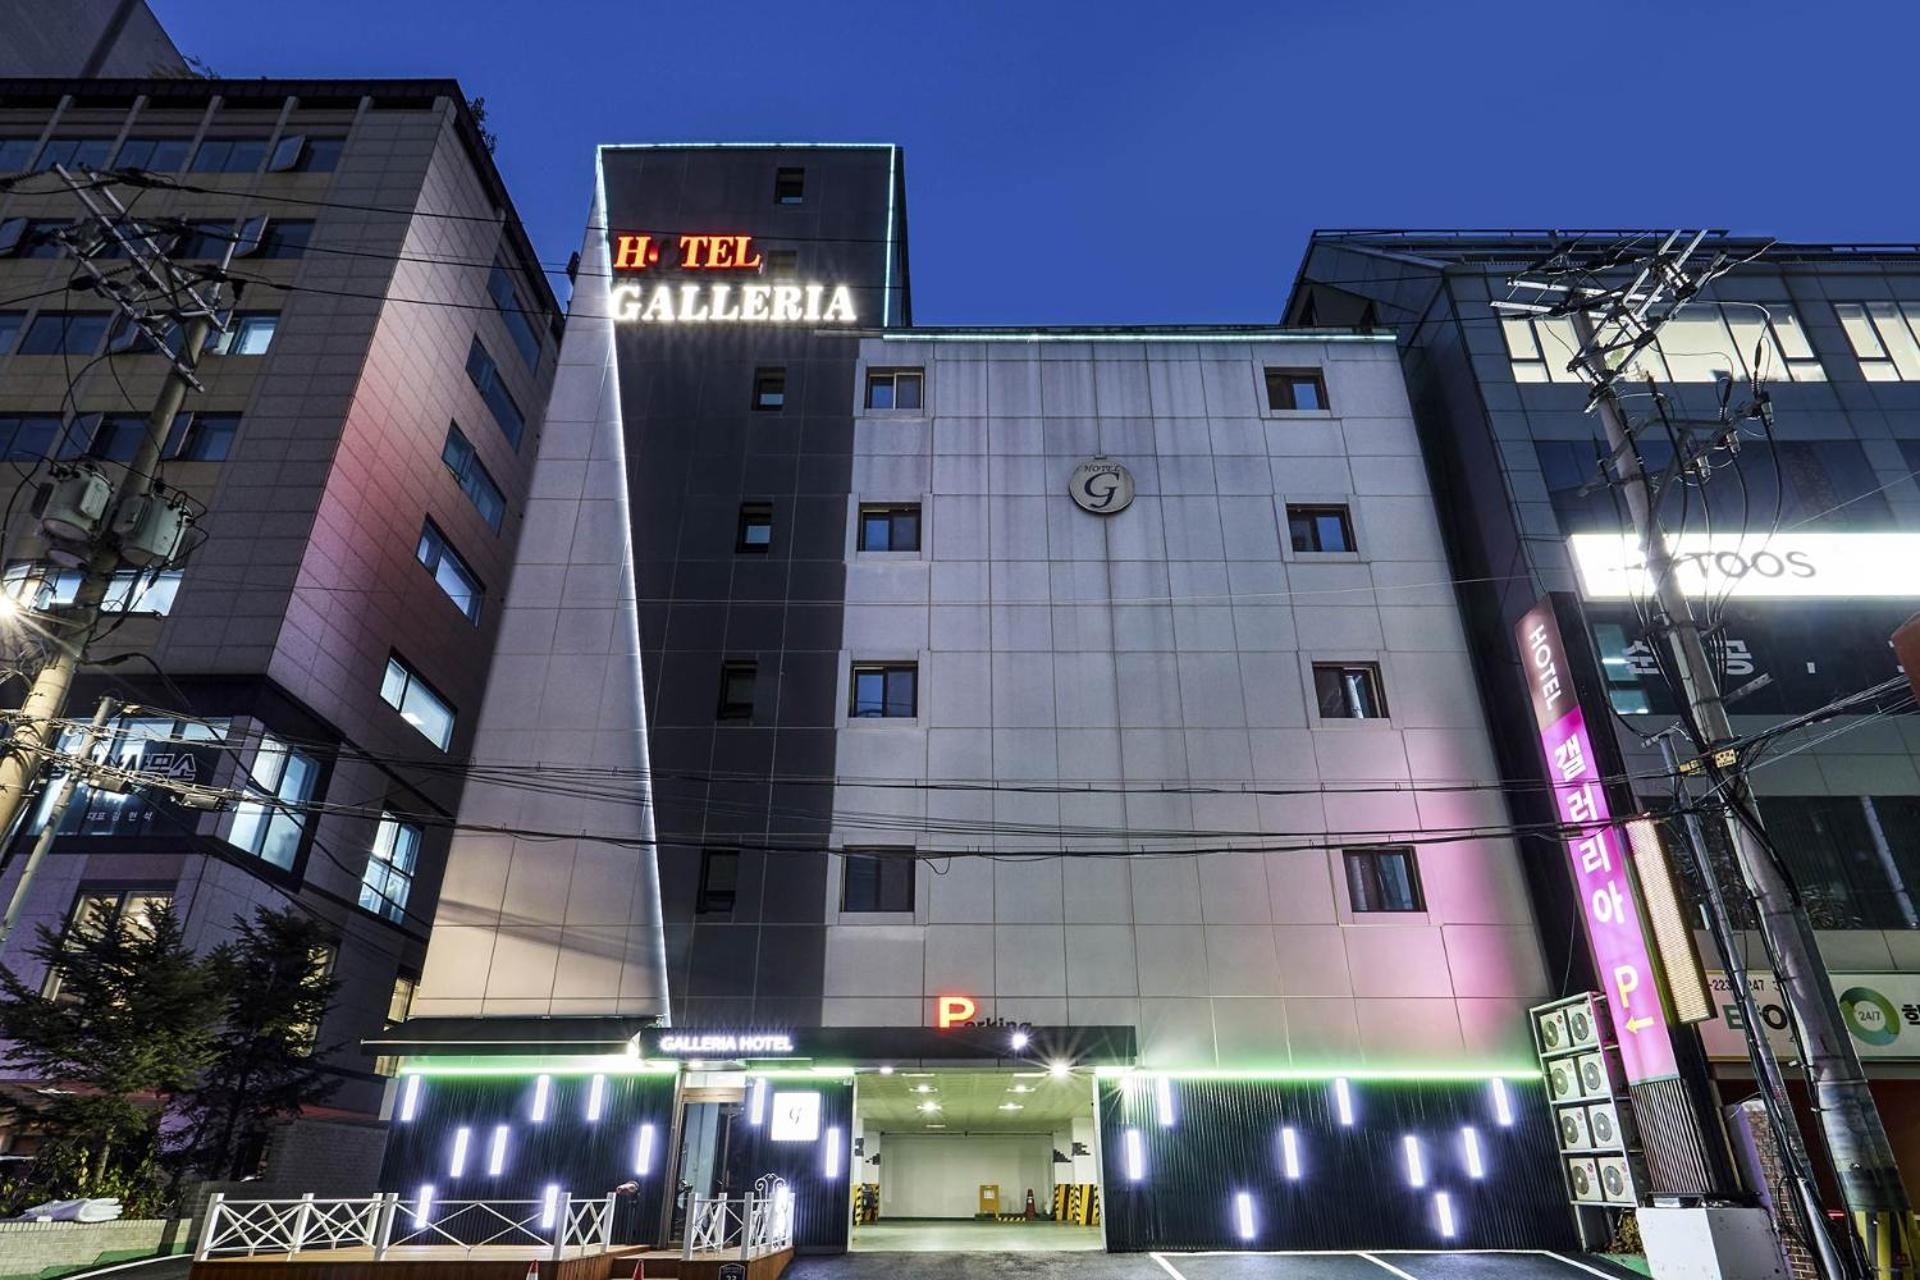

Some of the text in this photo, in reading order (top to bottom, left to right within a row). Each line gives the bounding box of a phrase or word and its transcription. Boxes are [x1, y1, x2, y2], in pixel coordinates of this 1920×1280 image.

[613, 236, 762, 268] HTEL
[609, 284, 858, 321] GALLERIA
[1084, 471, 1119, 508] G
[1528, 624, 1562, 711] HOTEL
[1554, 733, 1625, 925] 갤러리아
[1614, 964, 1639, 1008] P
[660, 1035, 794, 1051] GALLERIA HOTEL
